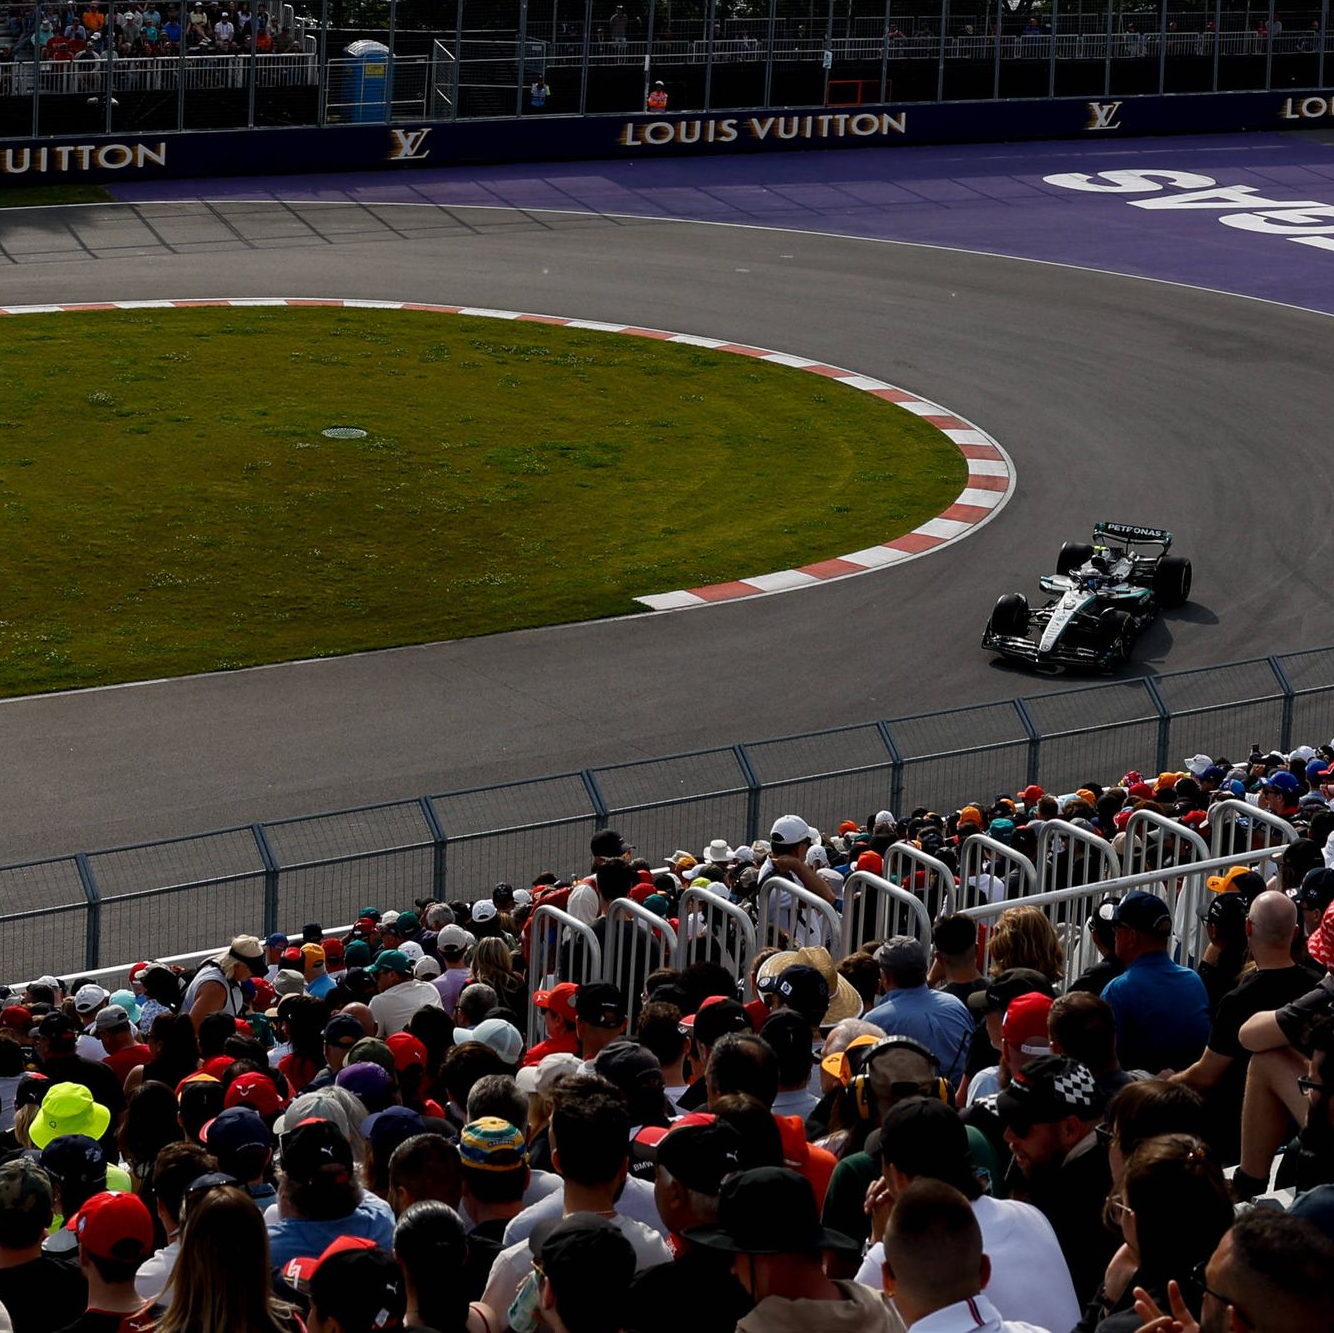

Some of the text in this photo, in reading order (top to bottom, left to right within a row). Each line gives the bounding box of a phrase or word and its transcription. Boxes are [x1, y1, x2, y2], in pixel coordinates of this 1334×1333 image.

[625, 112, 906, 146] LOUIS VUITTON
[1107, 523, 1162, 538] PETRONAS
[632, 1160, 654, 1172] BMW
